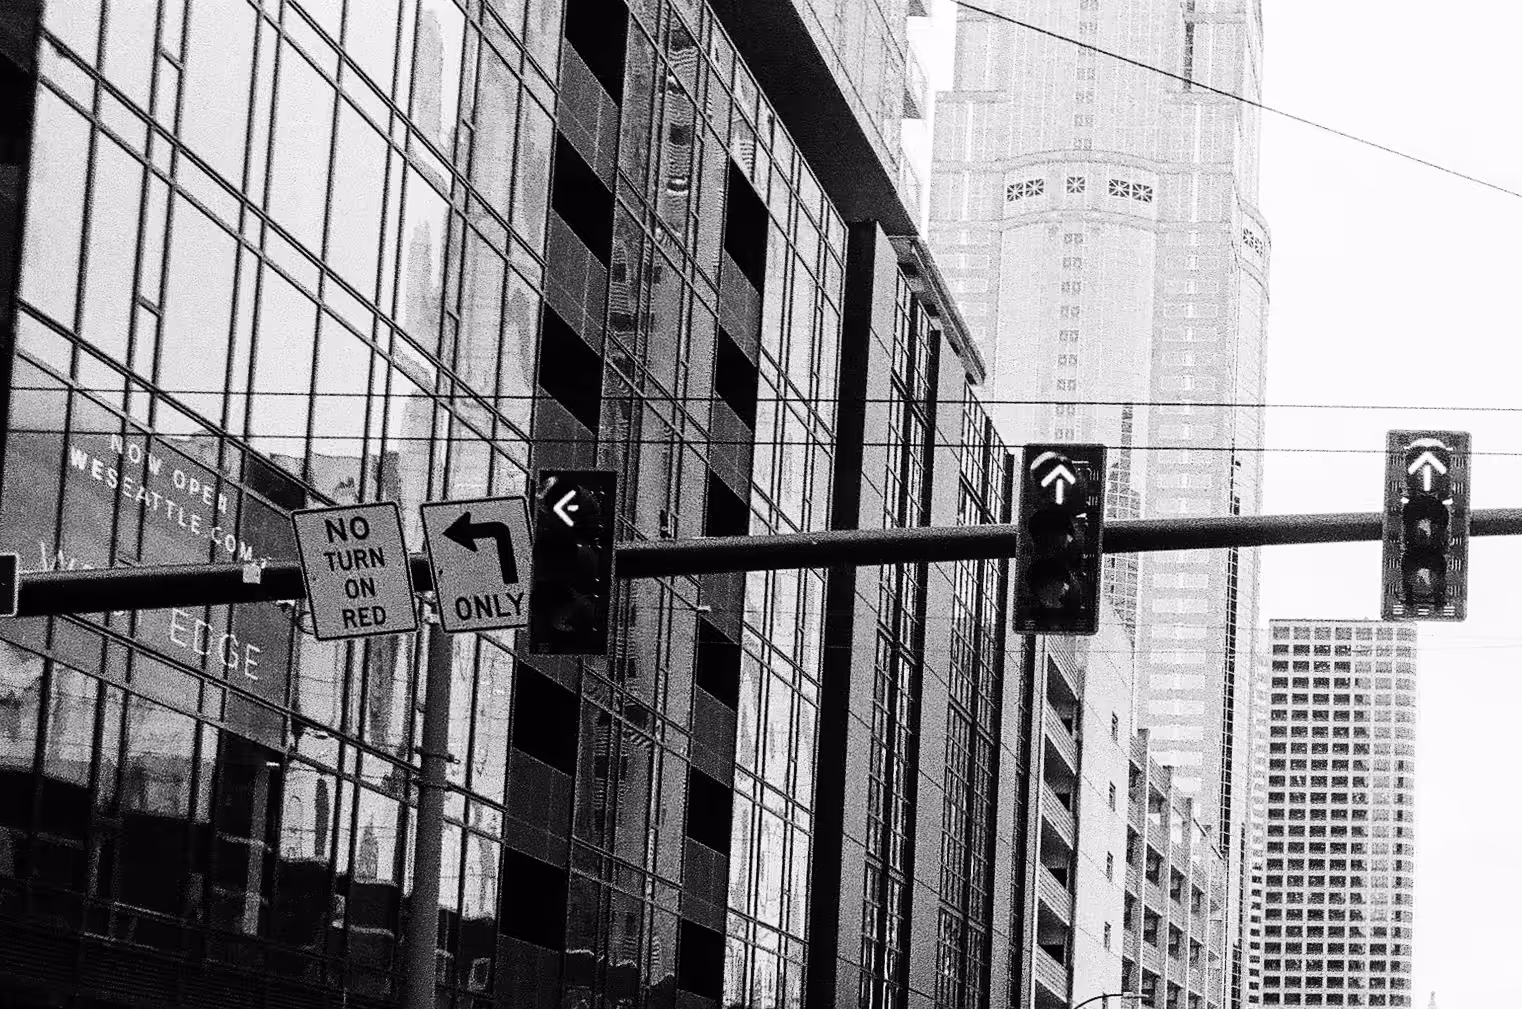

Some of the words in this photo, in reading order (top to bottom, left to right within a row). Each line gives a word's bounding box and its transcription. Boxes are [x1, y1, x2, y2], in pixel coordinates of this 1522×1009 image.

[111, 434, 162, 475] NOW
[173, 469, 228, 514] OPEN
[324, 516, 370, 543] NO
[323, 547, 386, 572] TURN
[344, 577, 376, 599] ON
[342, 605, 387, 629] RED
[455, 592, 524, 621] ONLY
[170, 607, 261, 680] EDGE
